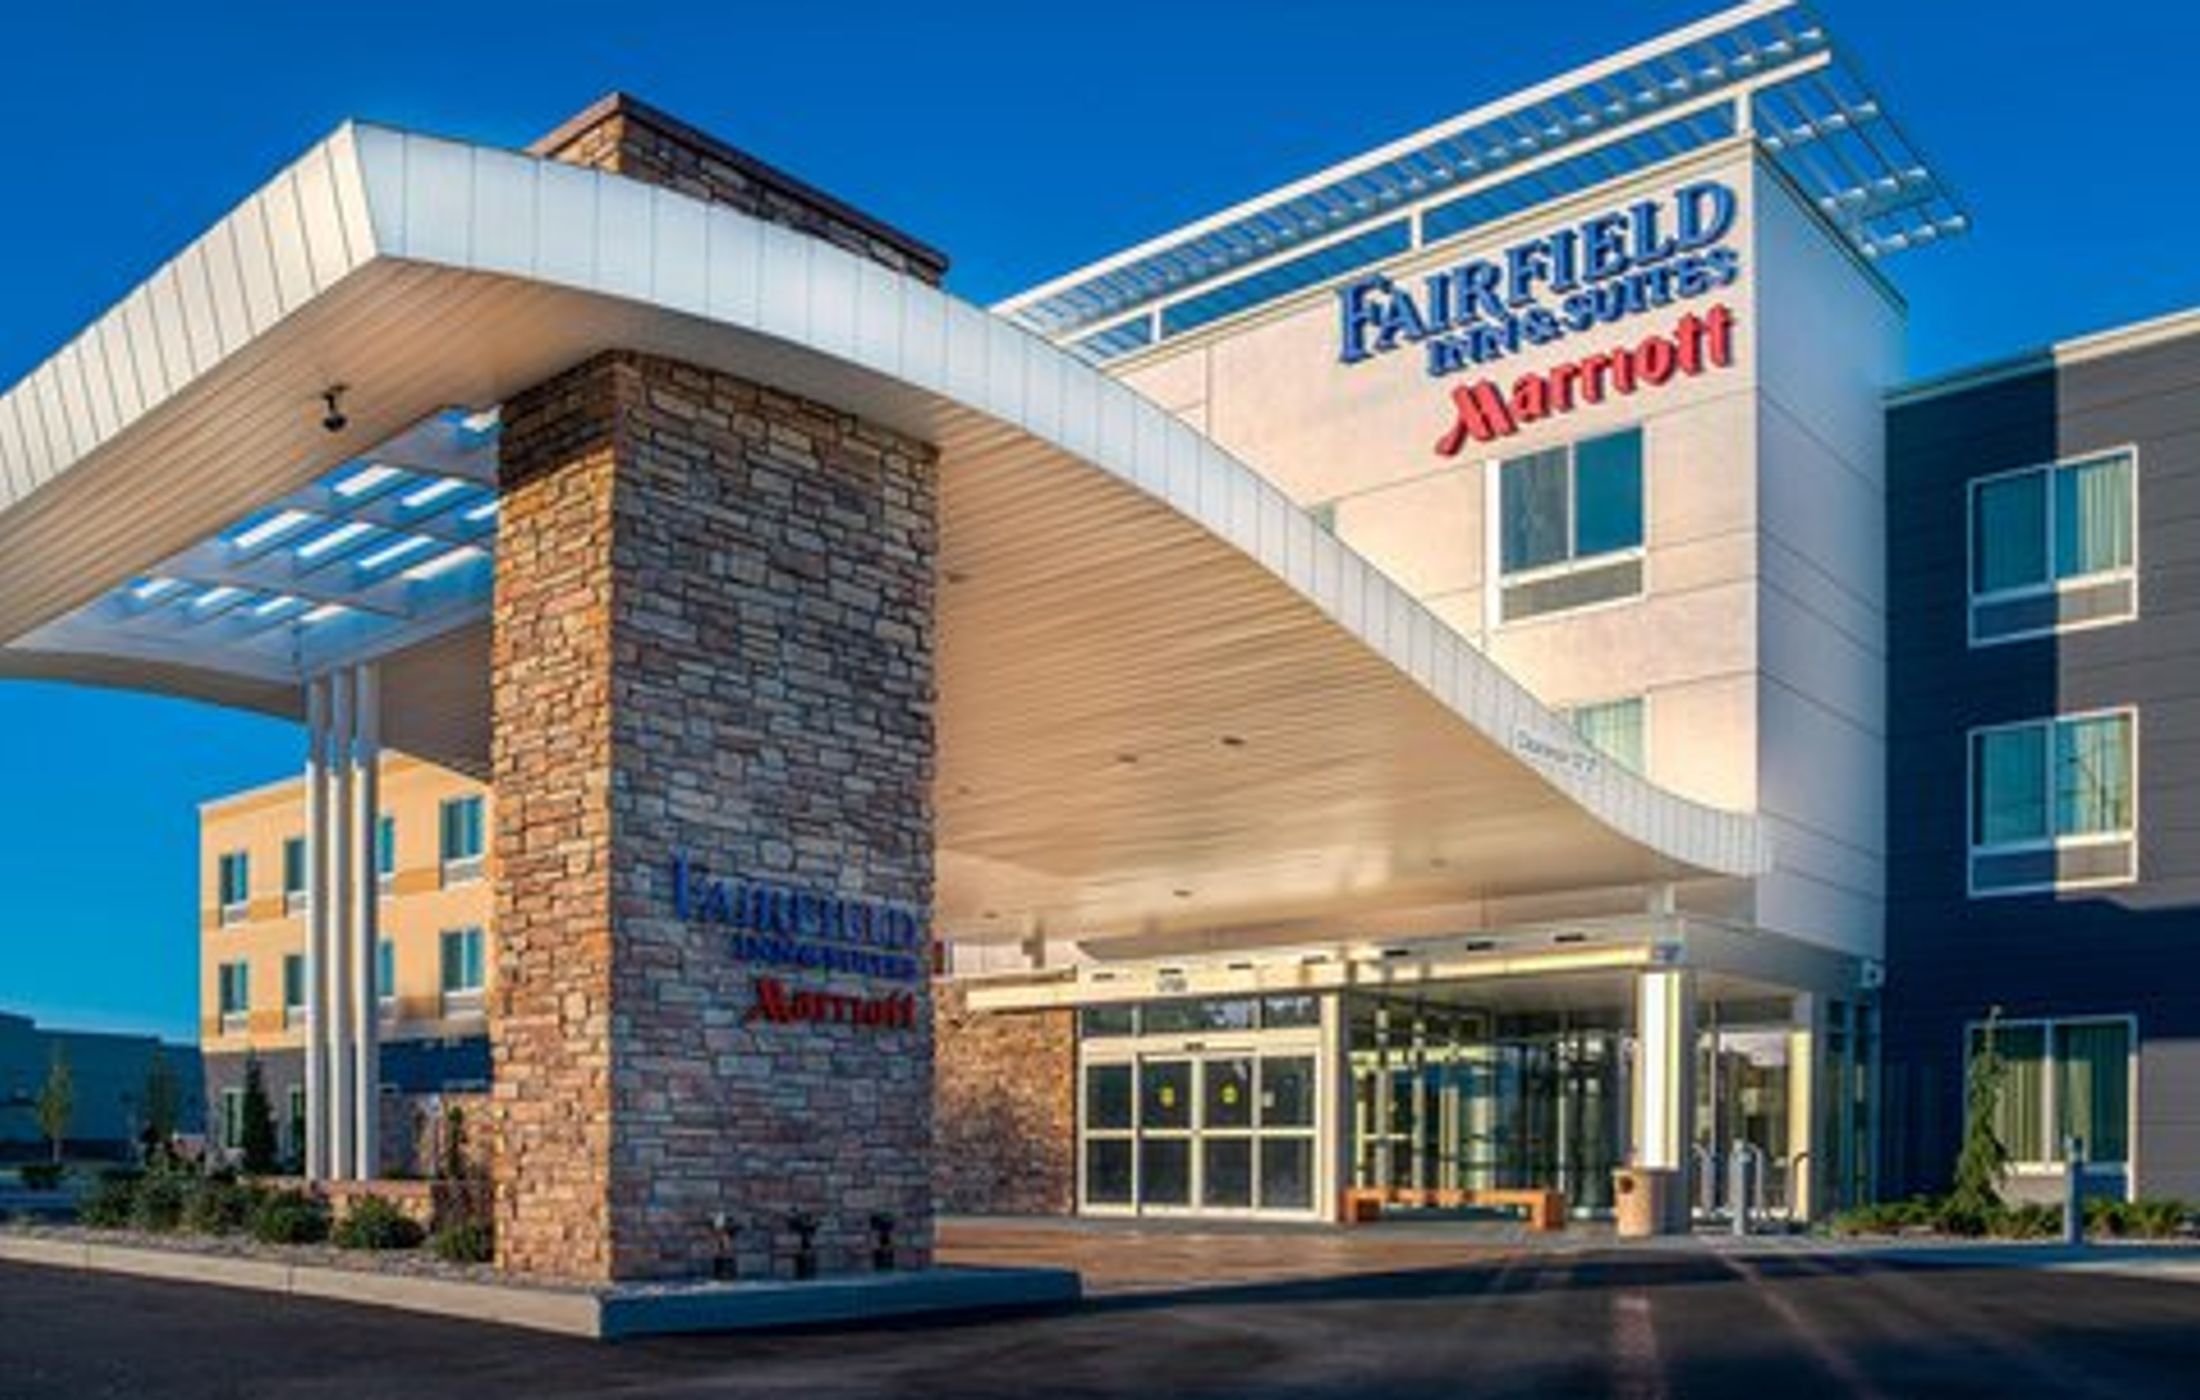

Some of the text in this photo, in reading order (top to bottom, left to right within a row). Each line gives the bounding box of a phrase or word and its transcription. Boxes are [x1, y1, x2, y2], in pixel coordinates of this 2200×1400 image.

[1335, 180, 1737, 364] FAIRFIELD
[1435, 303, 1736, 457] Marriott
[744, 974, 917, 1026] Marriott
